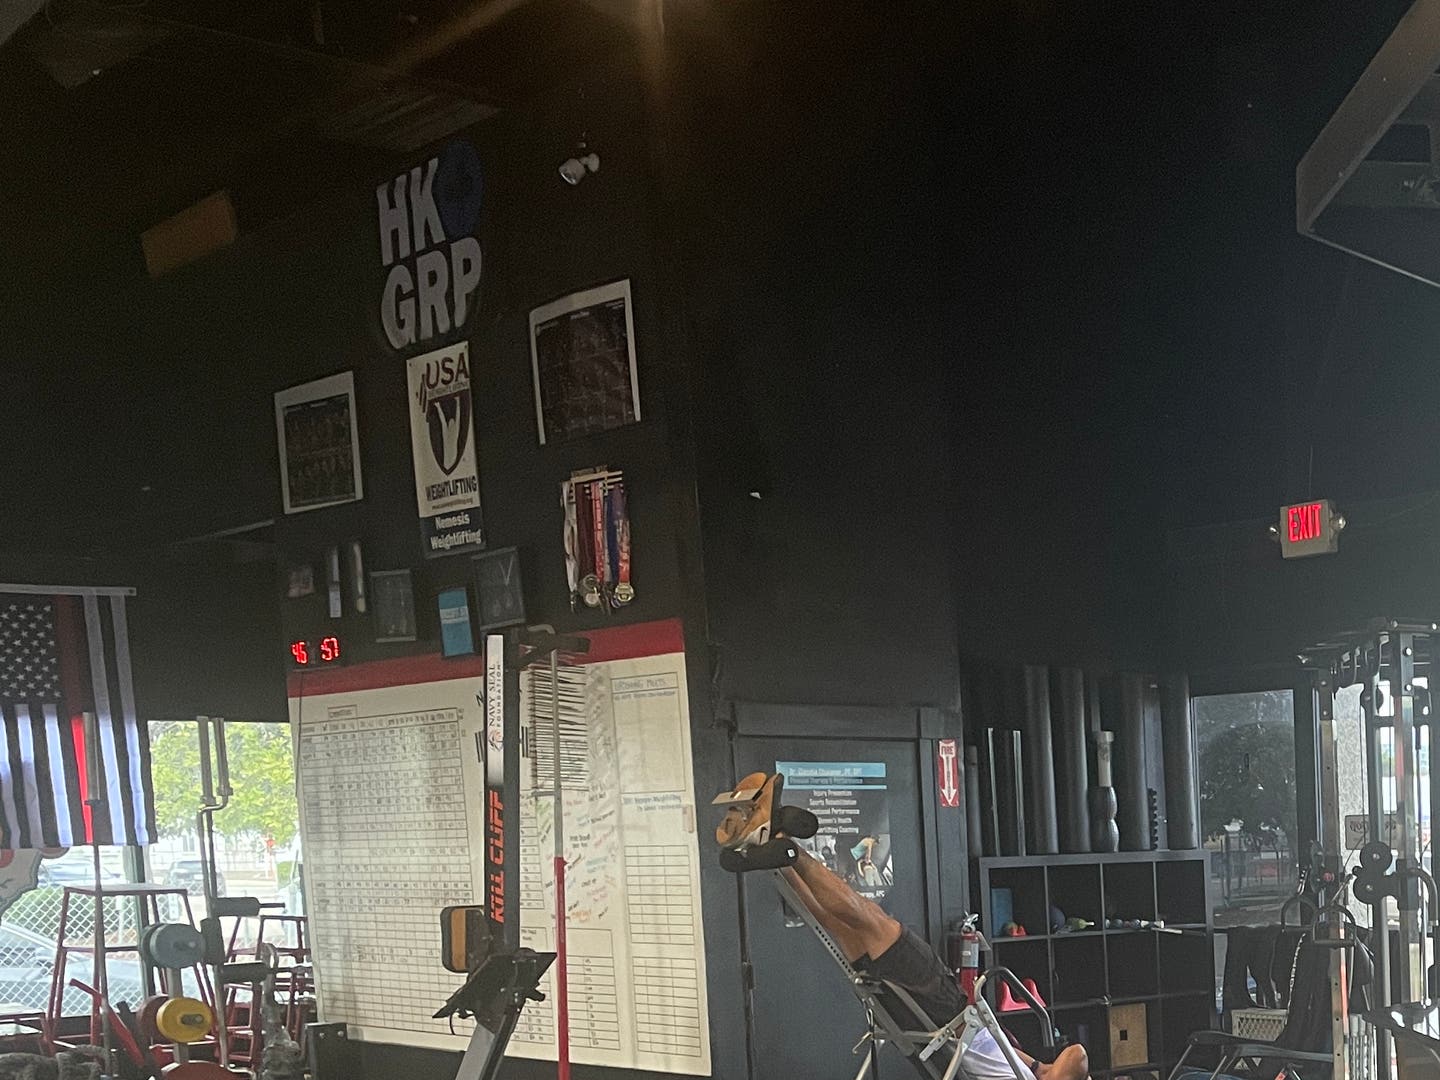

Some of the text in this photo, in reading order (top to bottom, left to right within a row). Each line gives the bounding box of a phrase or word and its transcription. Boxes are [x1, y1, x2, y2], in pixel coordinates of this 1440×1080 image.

[376, 158, 446, 267] HK
[381, 237, 482, 349] GRP
[425, 352, 469, 390] USA
[426, 476, 477, 501] WEIGHTLIFTING
[431, 529, 481, 550] Weightlifting
[435, 512, 470, 530] Nemesis
[1288, 504, 1322, 542] EXIT
[488, 663, 496, 727] NAVY SEAL
[489, 789, 505, 923] KILL CLIFF
